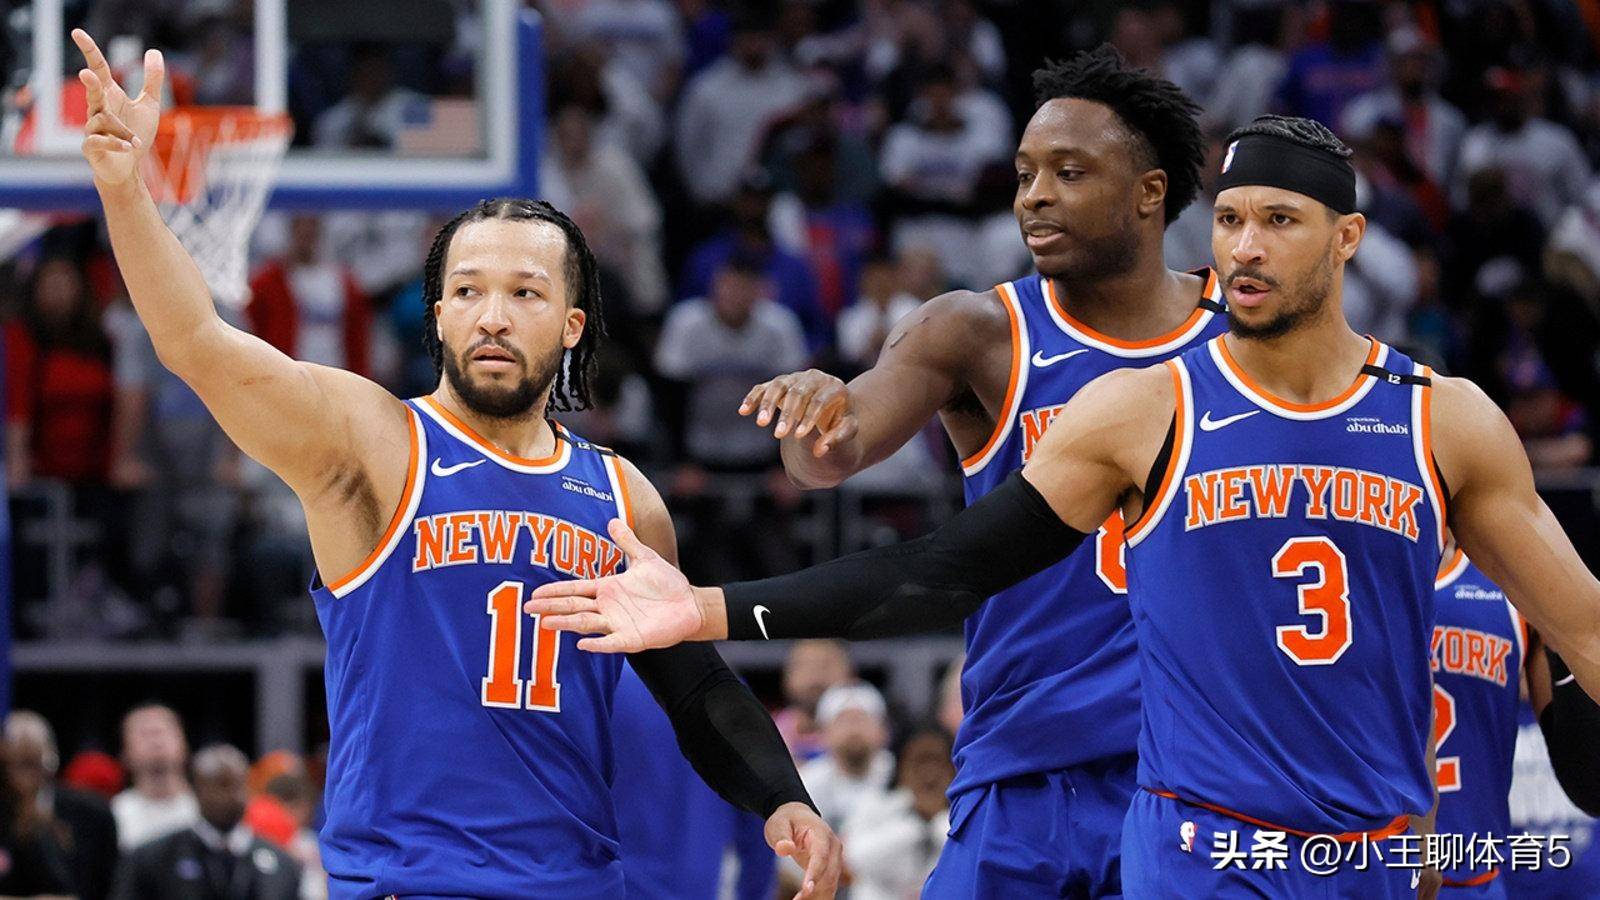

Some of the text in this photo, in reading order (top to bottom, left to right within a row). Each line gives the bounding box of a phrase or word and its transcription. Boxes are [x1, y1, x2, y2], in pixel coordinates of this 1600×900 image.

[1346, 422, 1408, 435] abu dhabi
[562, 481, 583, 494] abu
[1184, 464, 1425, 543] NEW YORK
[412, 510, 522, 573] NEW
[1270, 535, 1353, 666] 3
[481, 580, 561, 713] 11
